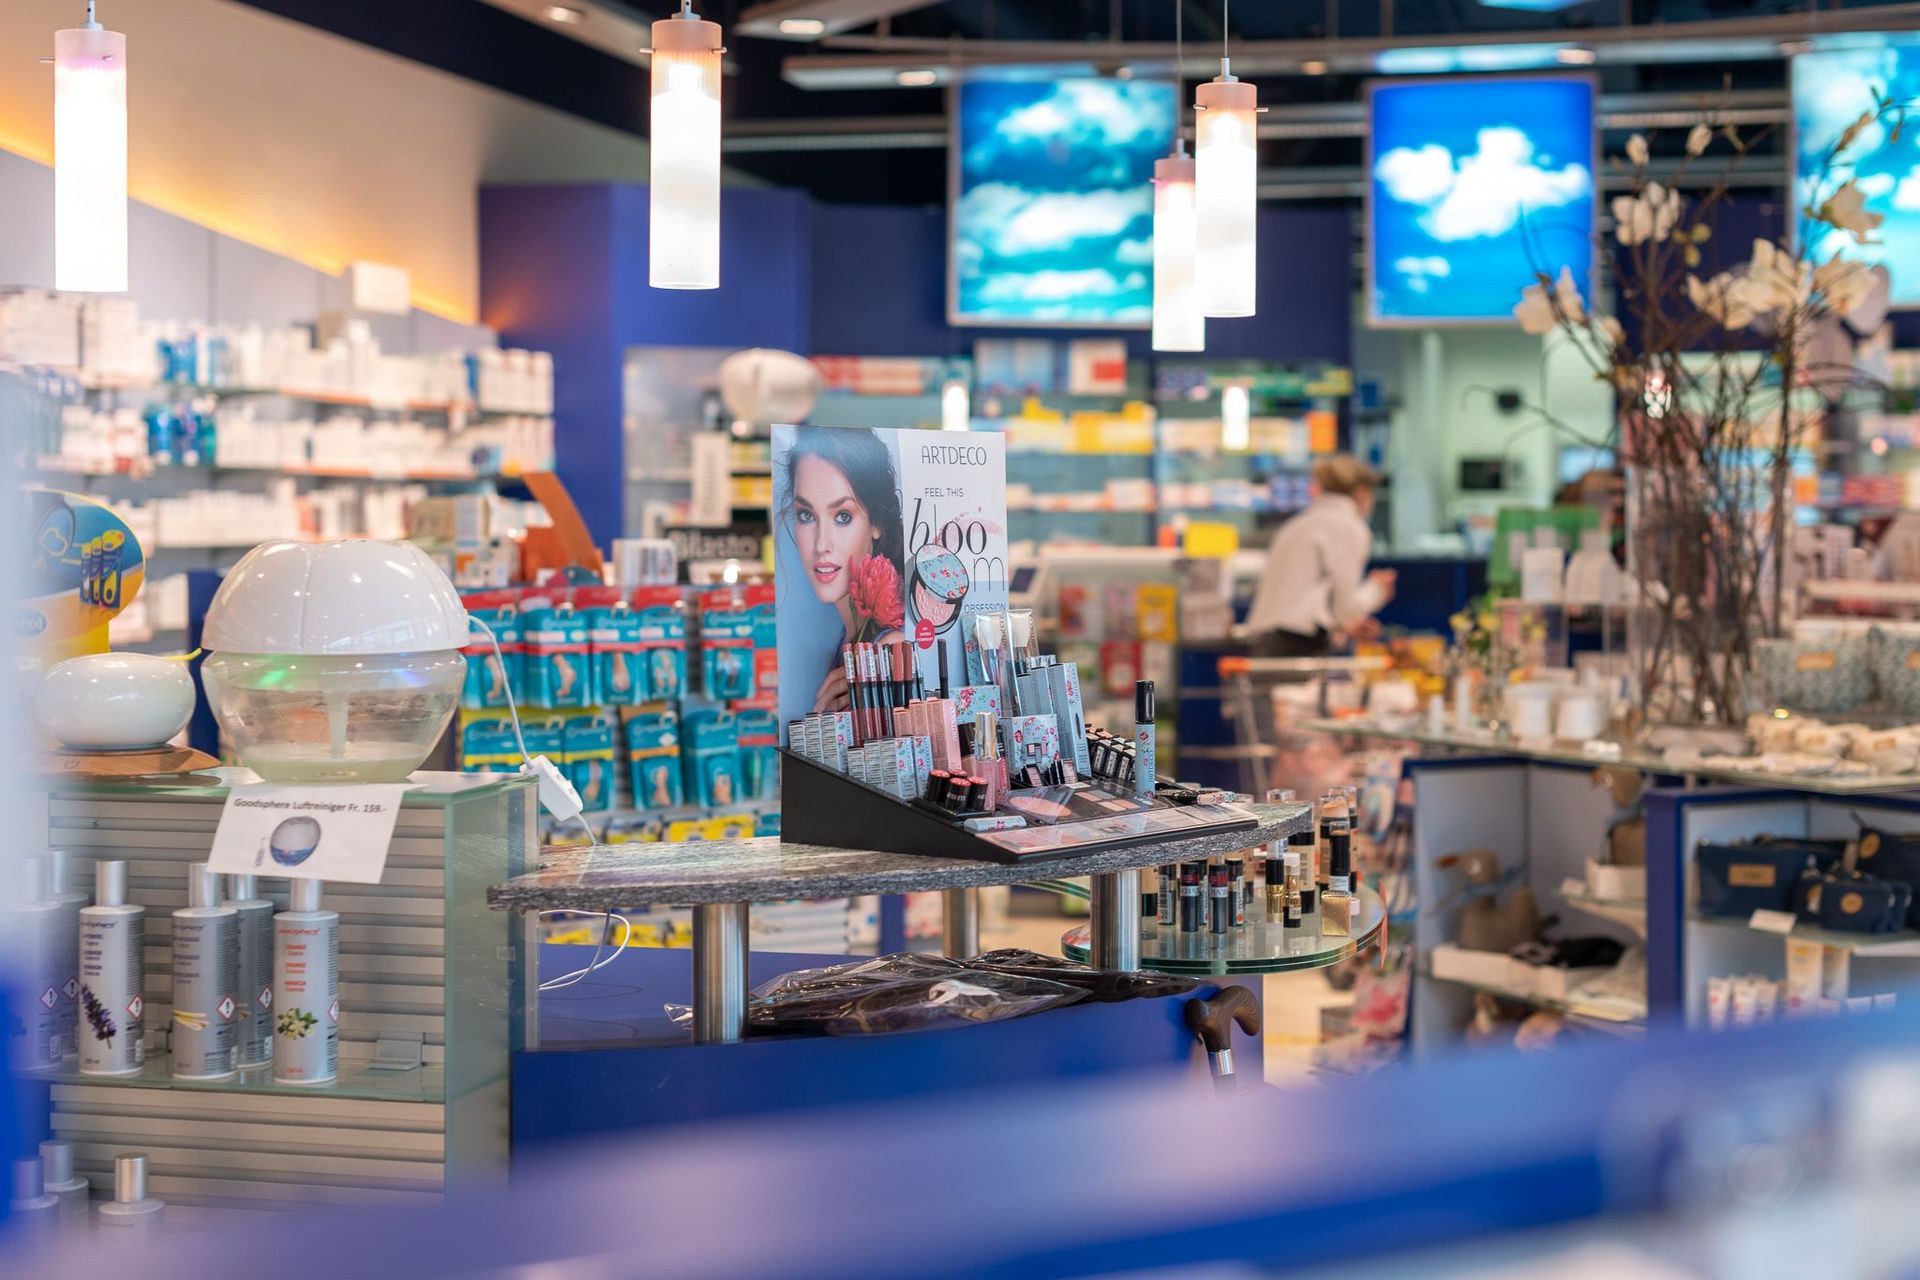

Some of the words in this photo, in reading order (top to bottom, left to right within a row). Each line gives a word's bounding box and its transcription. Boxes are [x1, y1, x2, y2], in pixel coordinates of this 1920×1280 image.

[921, 445, 987, 466] ARTDECO
[924, 488, 944, 498] FEEL
[946, 488, 965, 498] THIS
[964, 602, 1006, 615] OBSESSION
[233, 798, 290, 810] Goodsphere
[292, 801, 346, 813] Luftreiniger
[347, 803, 360, 813] Fr.
